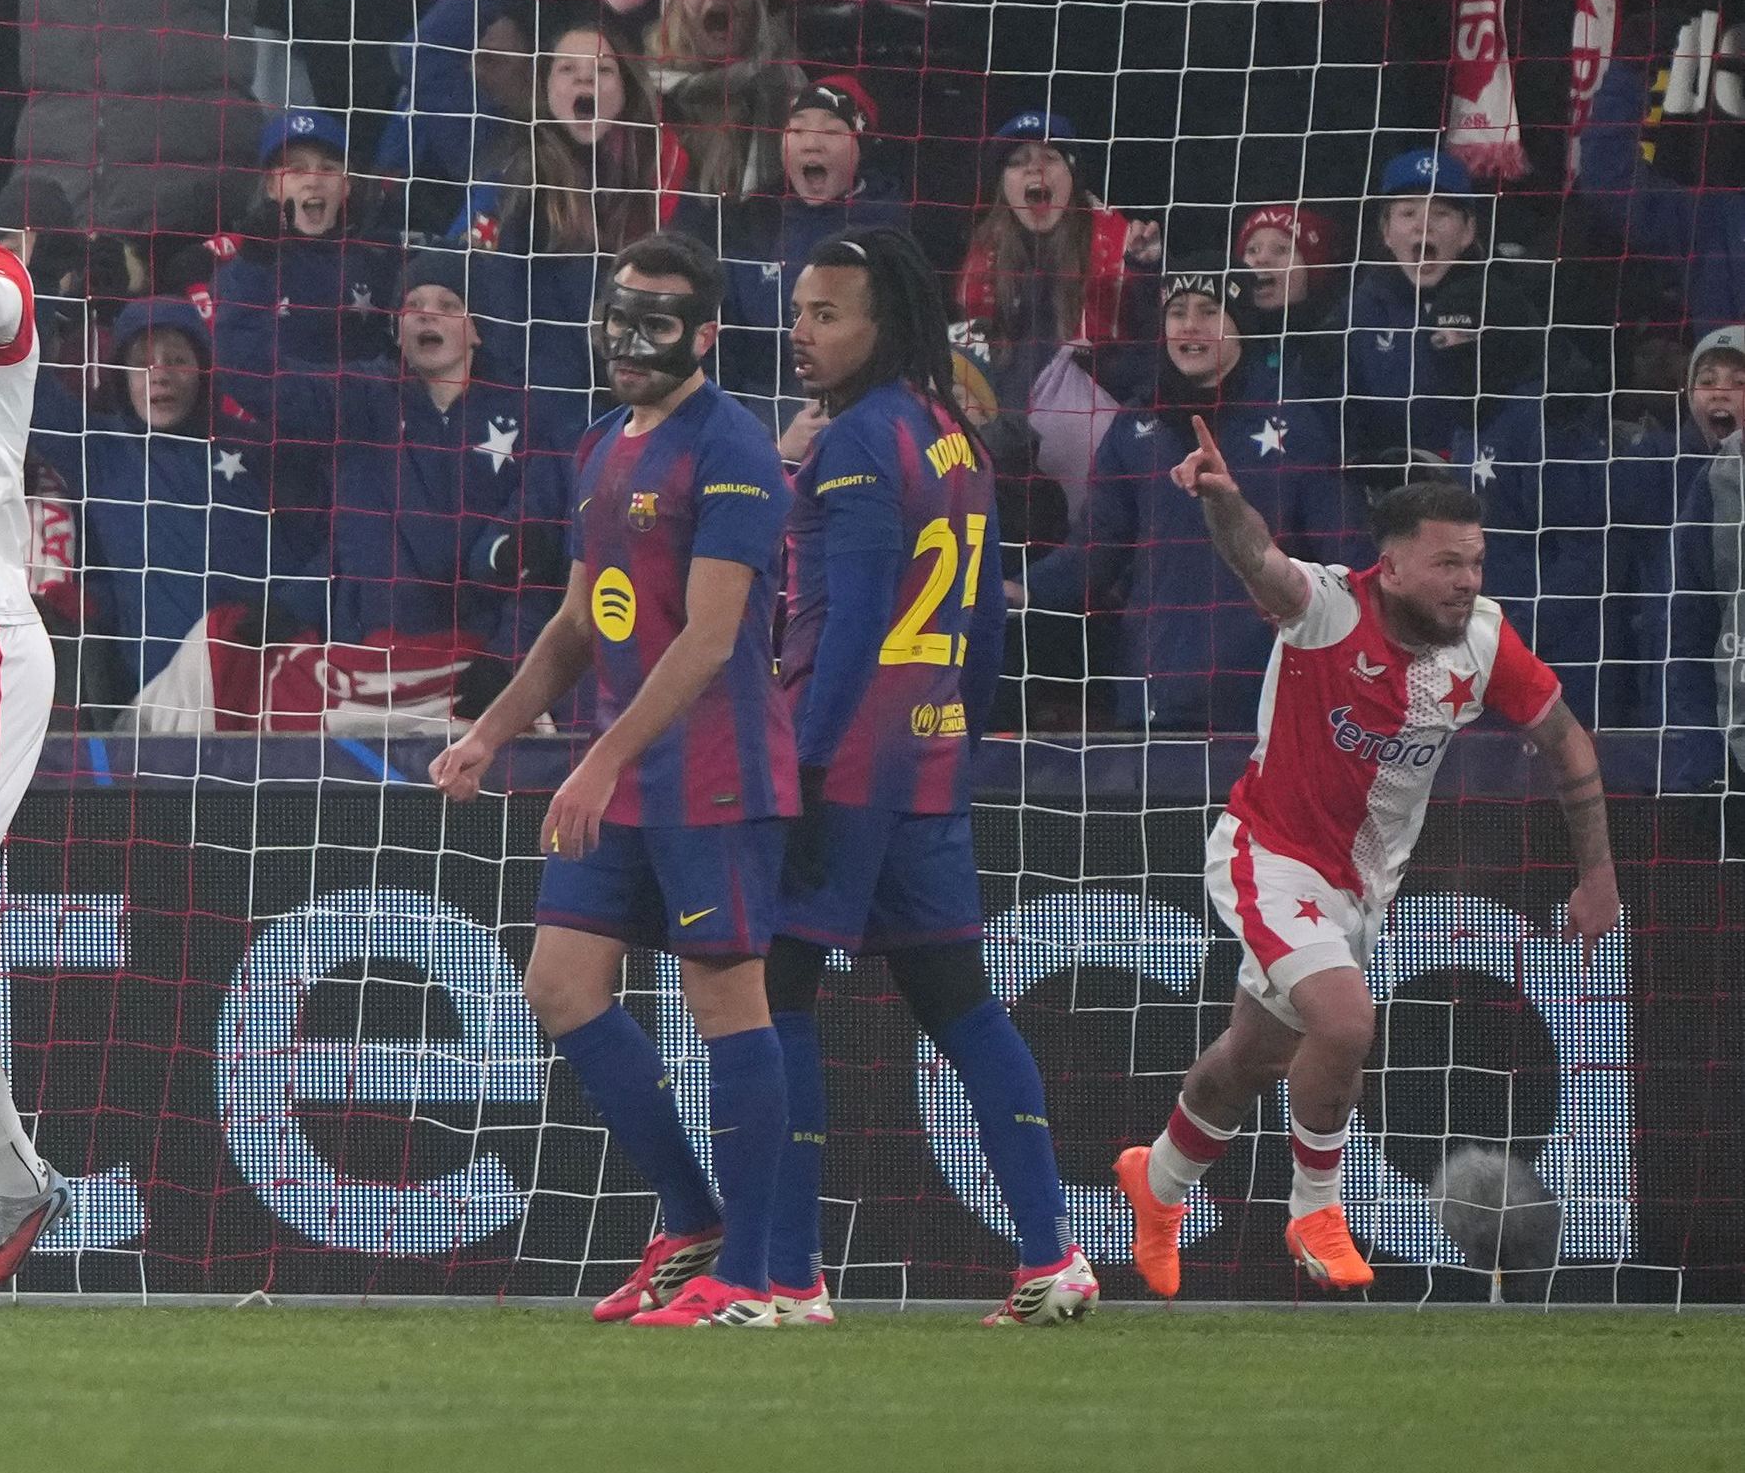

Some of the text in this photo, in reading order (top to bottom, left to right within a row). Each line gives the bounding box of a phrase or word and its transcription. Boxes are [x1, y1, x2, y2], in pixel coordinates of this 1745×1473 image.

[703, 483, 761, 498] AMBILIGHT
[816, 475, 877, 496] AMBILIGHT tv
